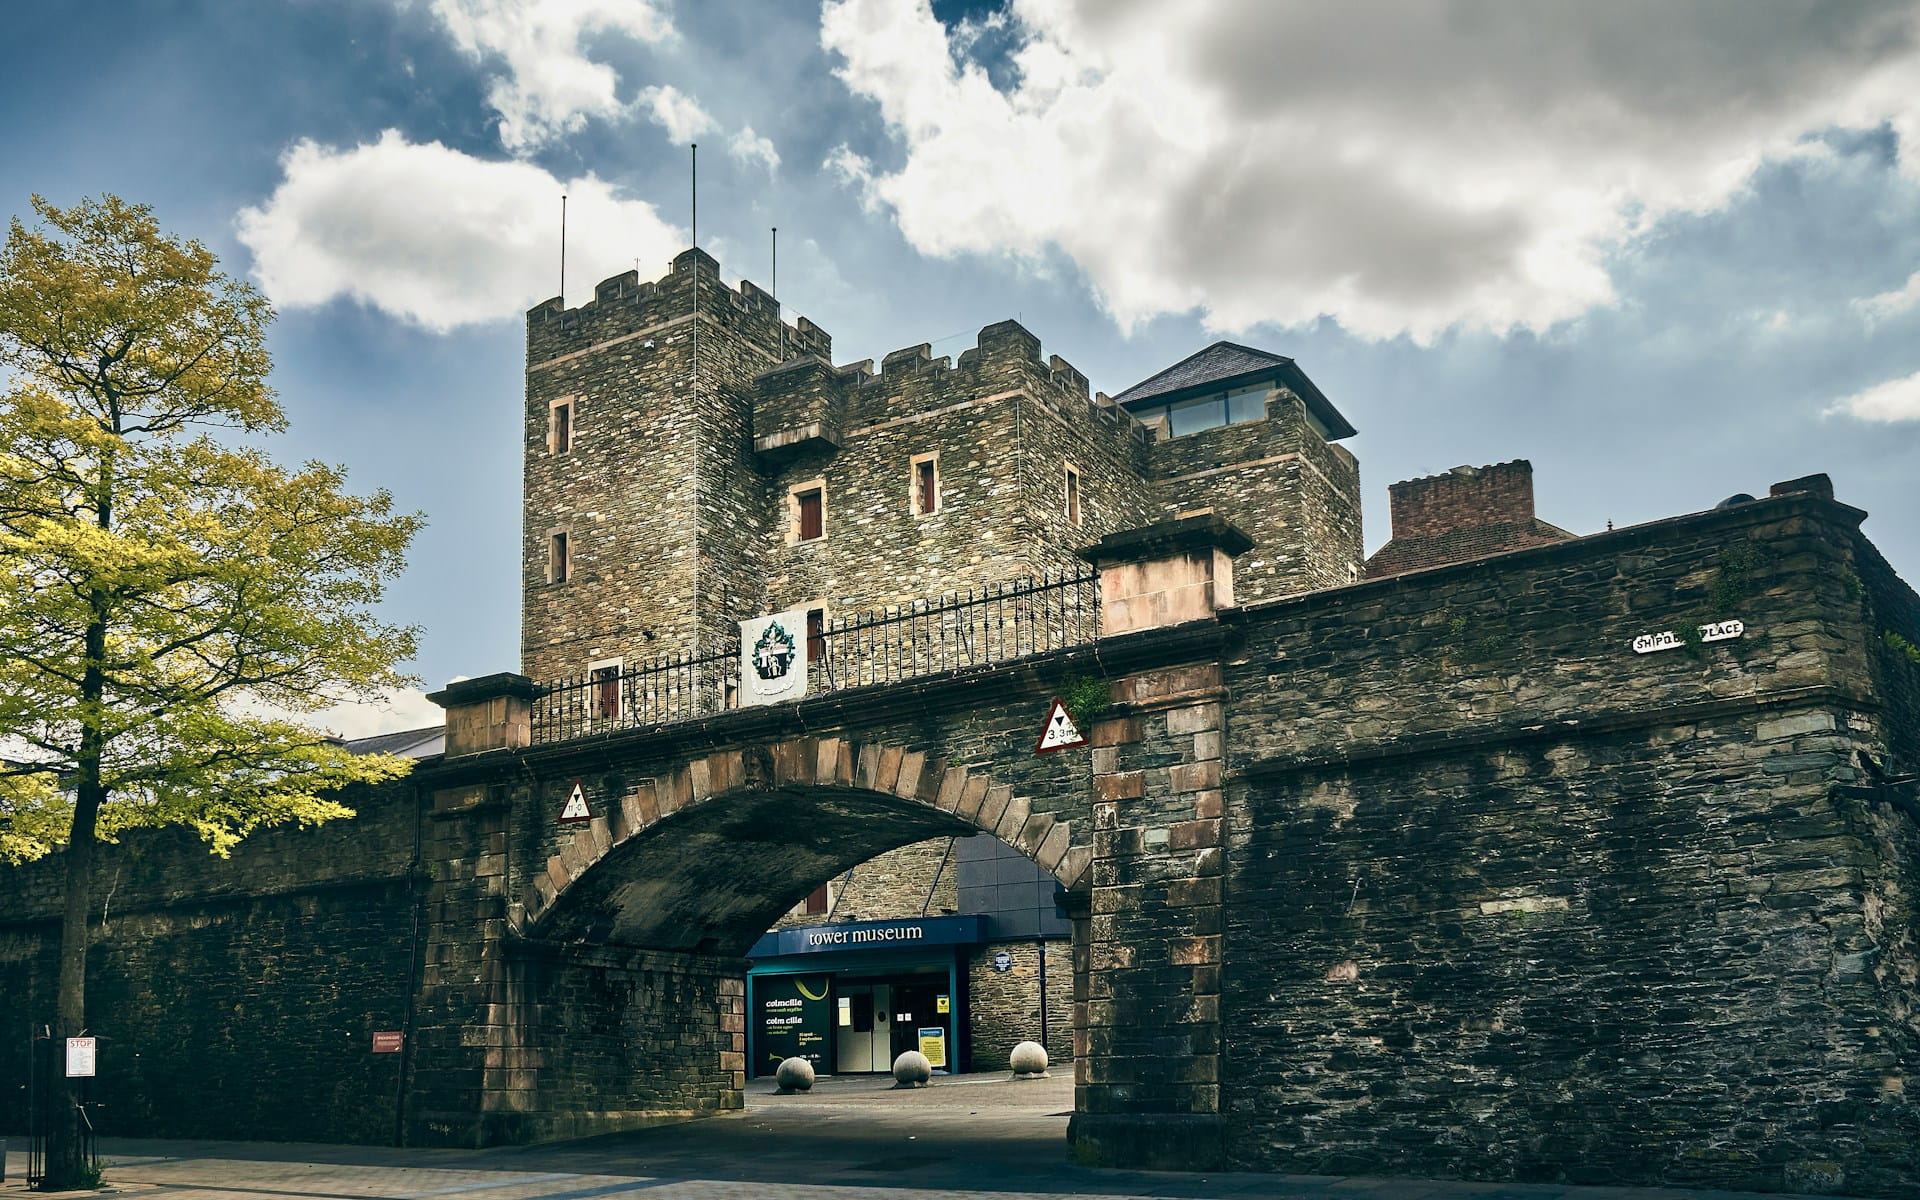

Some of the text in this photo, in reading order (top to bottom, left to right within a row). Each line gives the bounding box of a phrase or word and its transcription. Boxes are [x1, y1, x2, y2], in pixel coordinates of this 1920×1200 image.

[1700, 624, 1740, 638] PLACE
[809, 926, 922, 946] tower museum
[766, 999, 802, 1007] colmcille
[766, 1017, 785, 1025] colm
[70, 1040, 92, 1048] STOP
